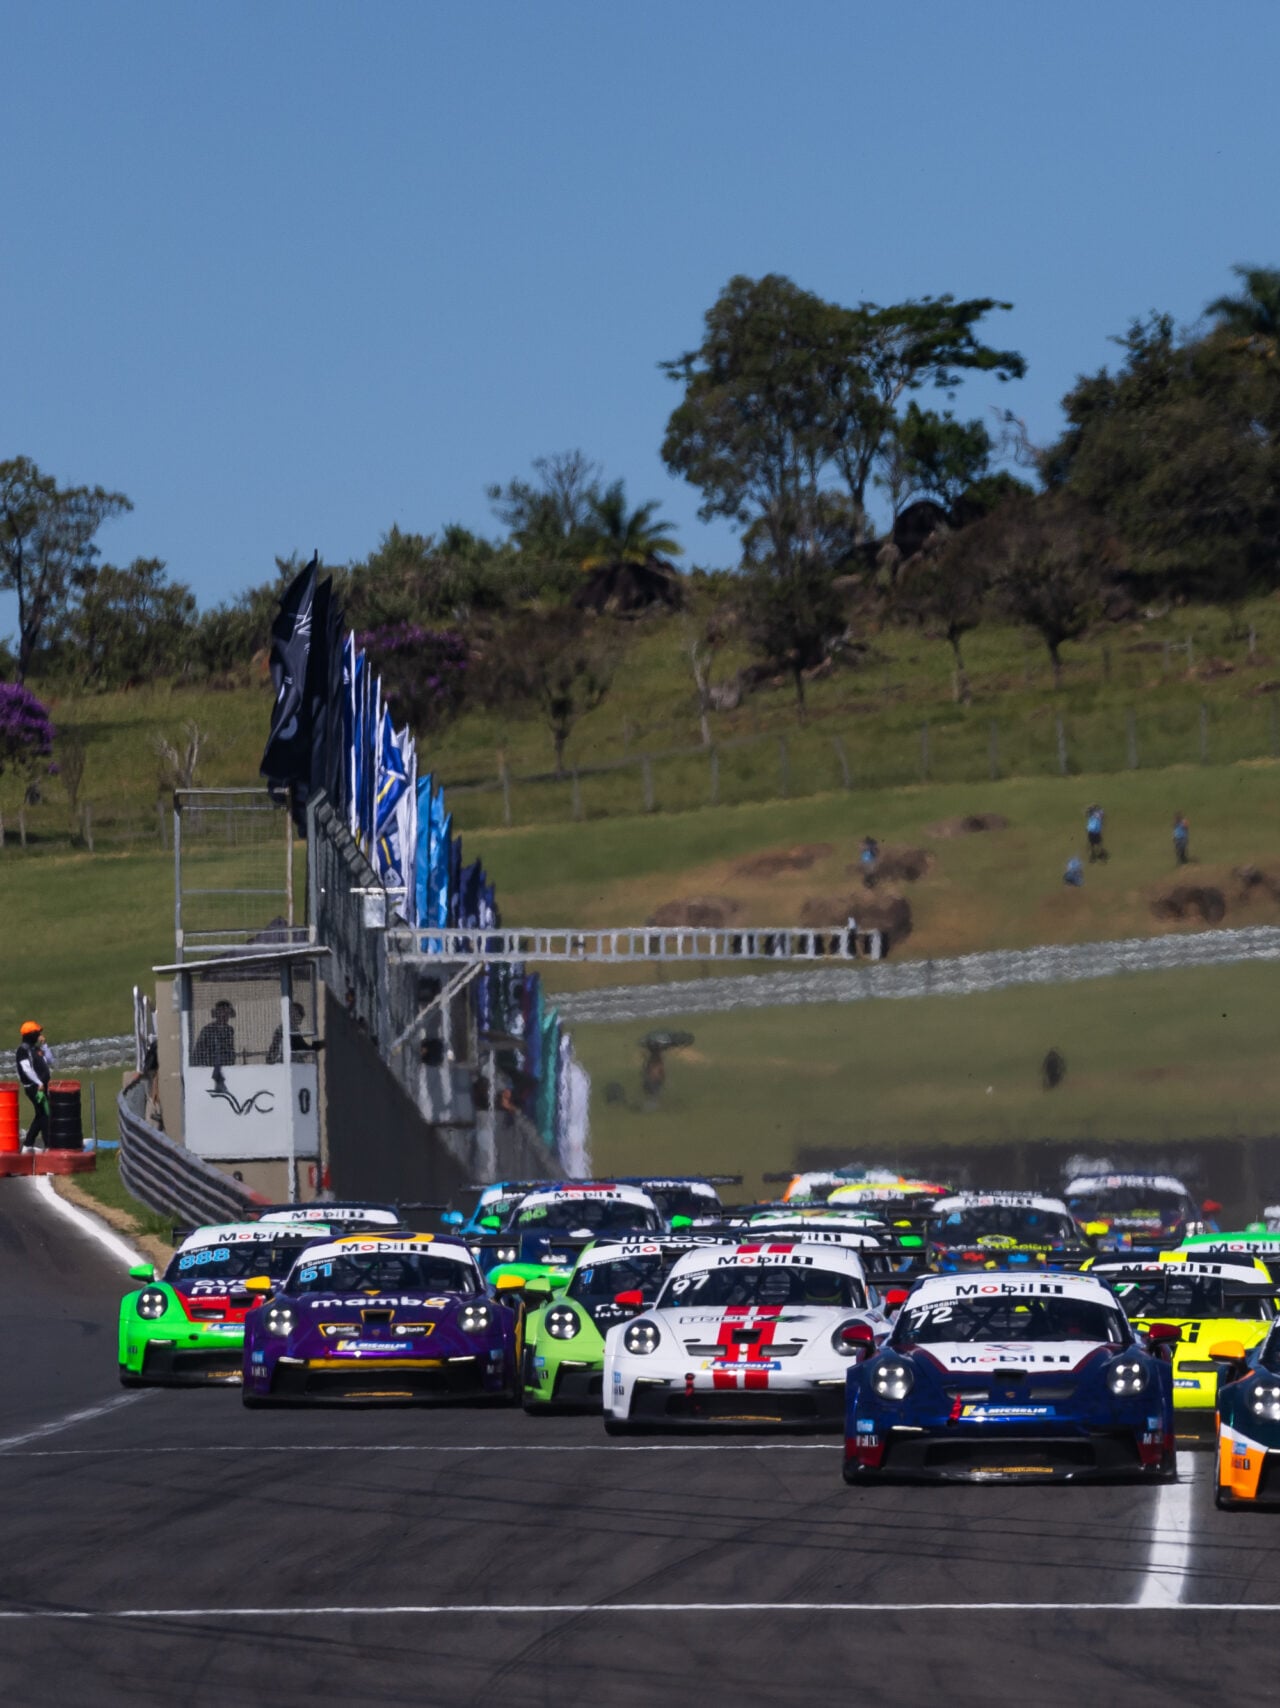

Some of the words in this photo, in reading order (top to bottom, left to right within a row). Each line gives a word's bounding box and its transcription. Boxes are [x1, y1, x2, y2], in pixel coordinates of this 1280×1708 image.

[292, 1211, 345, 1220] Mobil
[341, 1242, 405, 1253] Mobil
[1209, 1243, 1273, 1253] Mobil
[179, 1247, 231, 1270] 888
[718, 1255, 787, 1266] Mobil
[1121, 1263, 1194, 1273] Mobil
[672, 1275, 710, 1295] 97
[956, 1283, 1034, 1296] Mobil
[911, 1306, 953, 1330] 72
[951, 1355, 1035, 1364] Mobil
